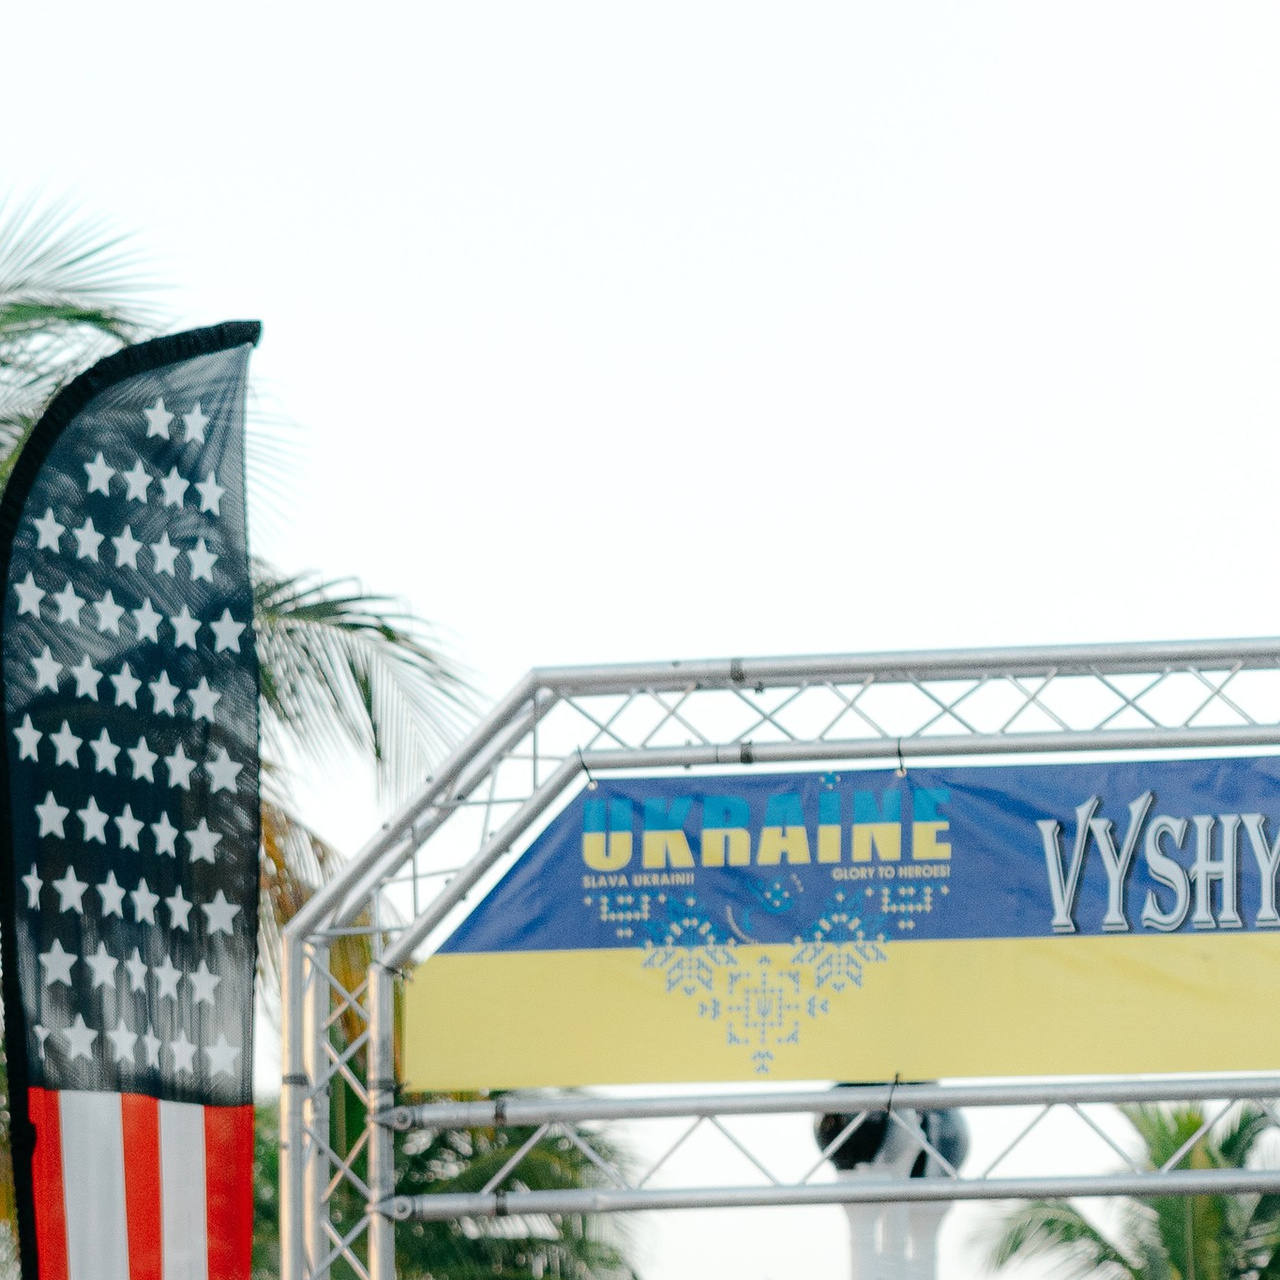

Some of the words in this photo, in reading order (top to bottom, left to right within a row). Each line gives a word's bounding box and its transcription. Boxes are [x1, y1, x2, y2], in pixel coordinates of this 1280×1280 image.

[582, 785, 952, 872] UKRAINE
[582, 874, 629, 889] SLAVA
[832, 866, 875, 881] GLORY
[878, 865, 896, 880] TO
[898, 864, 950, 879] HEROES!
[1036, 790, 1280, 934] VYSHY
